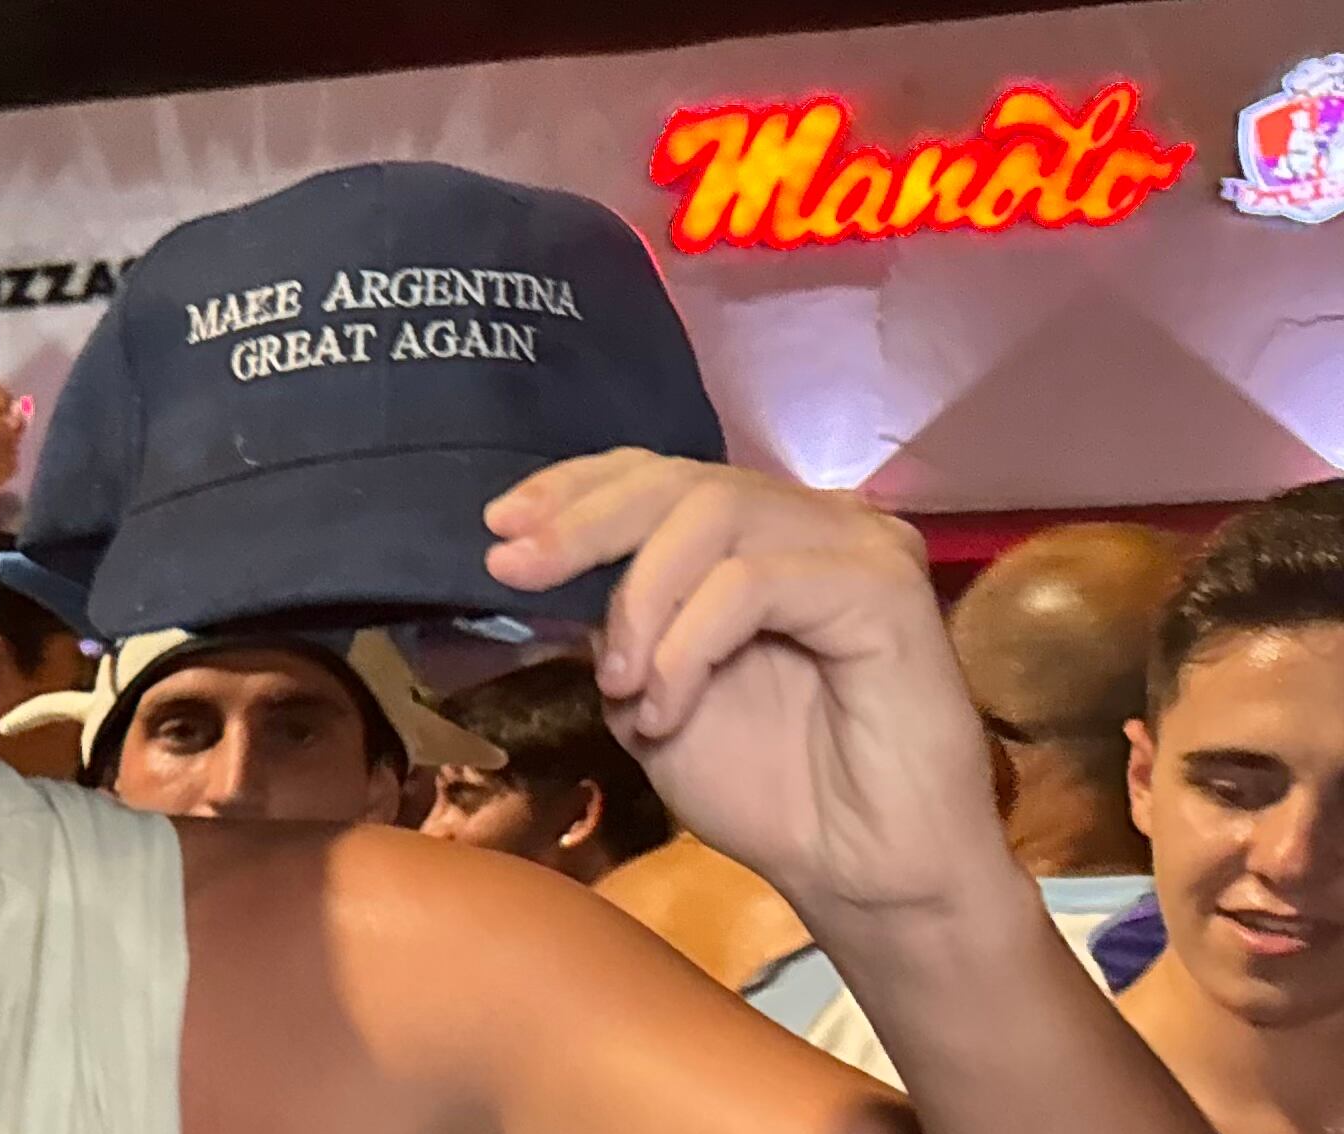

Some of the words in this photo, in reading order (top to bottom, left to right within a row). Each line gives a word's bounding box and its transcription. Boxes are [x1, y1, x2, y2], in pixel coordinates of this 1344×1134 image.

[652, 83, 1194, 252] Manolo
[185, 279, 303, 345] MAKE
[321, 267, 583, 321] ARGENTINA
[230, 323, 378, 382] GREAT
[389, 318, 539, 363] AGAIN
